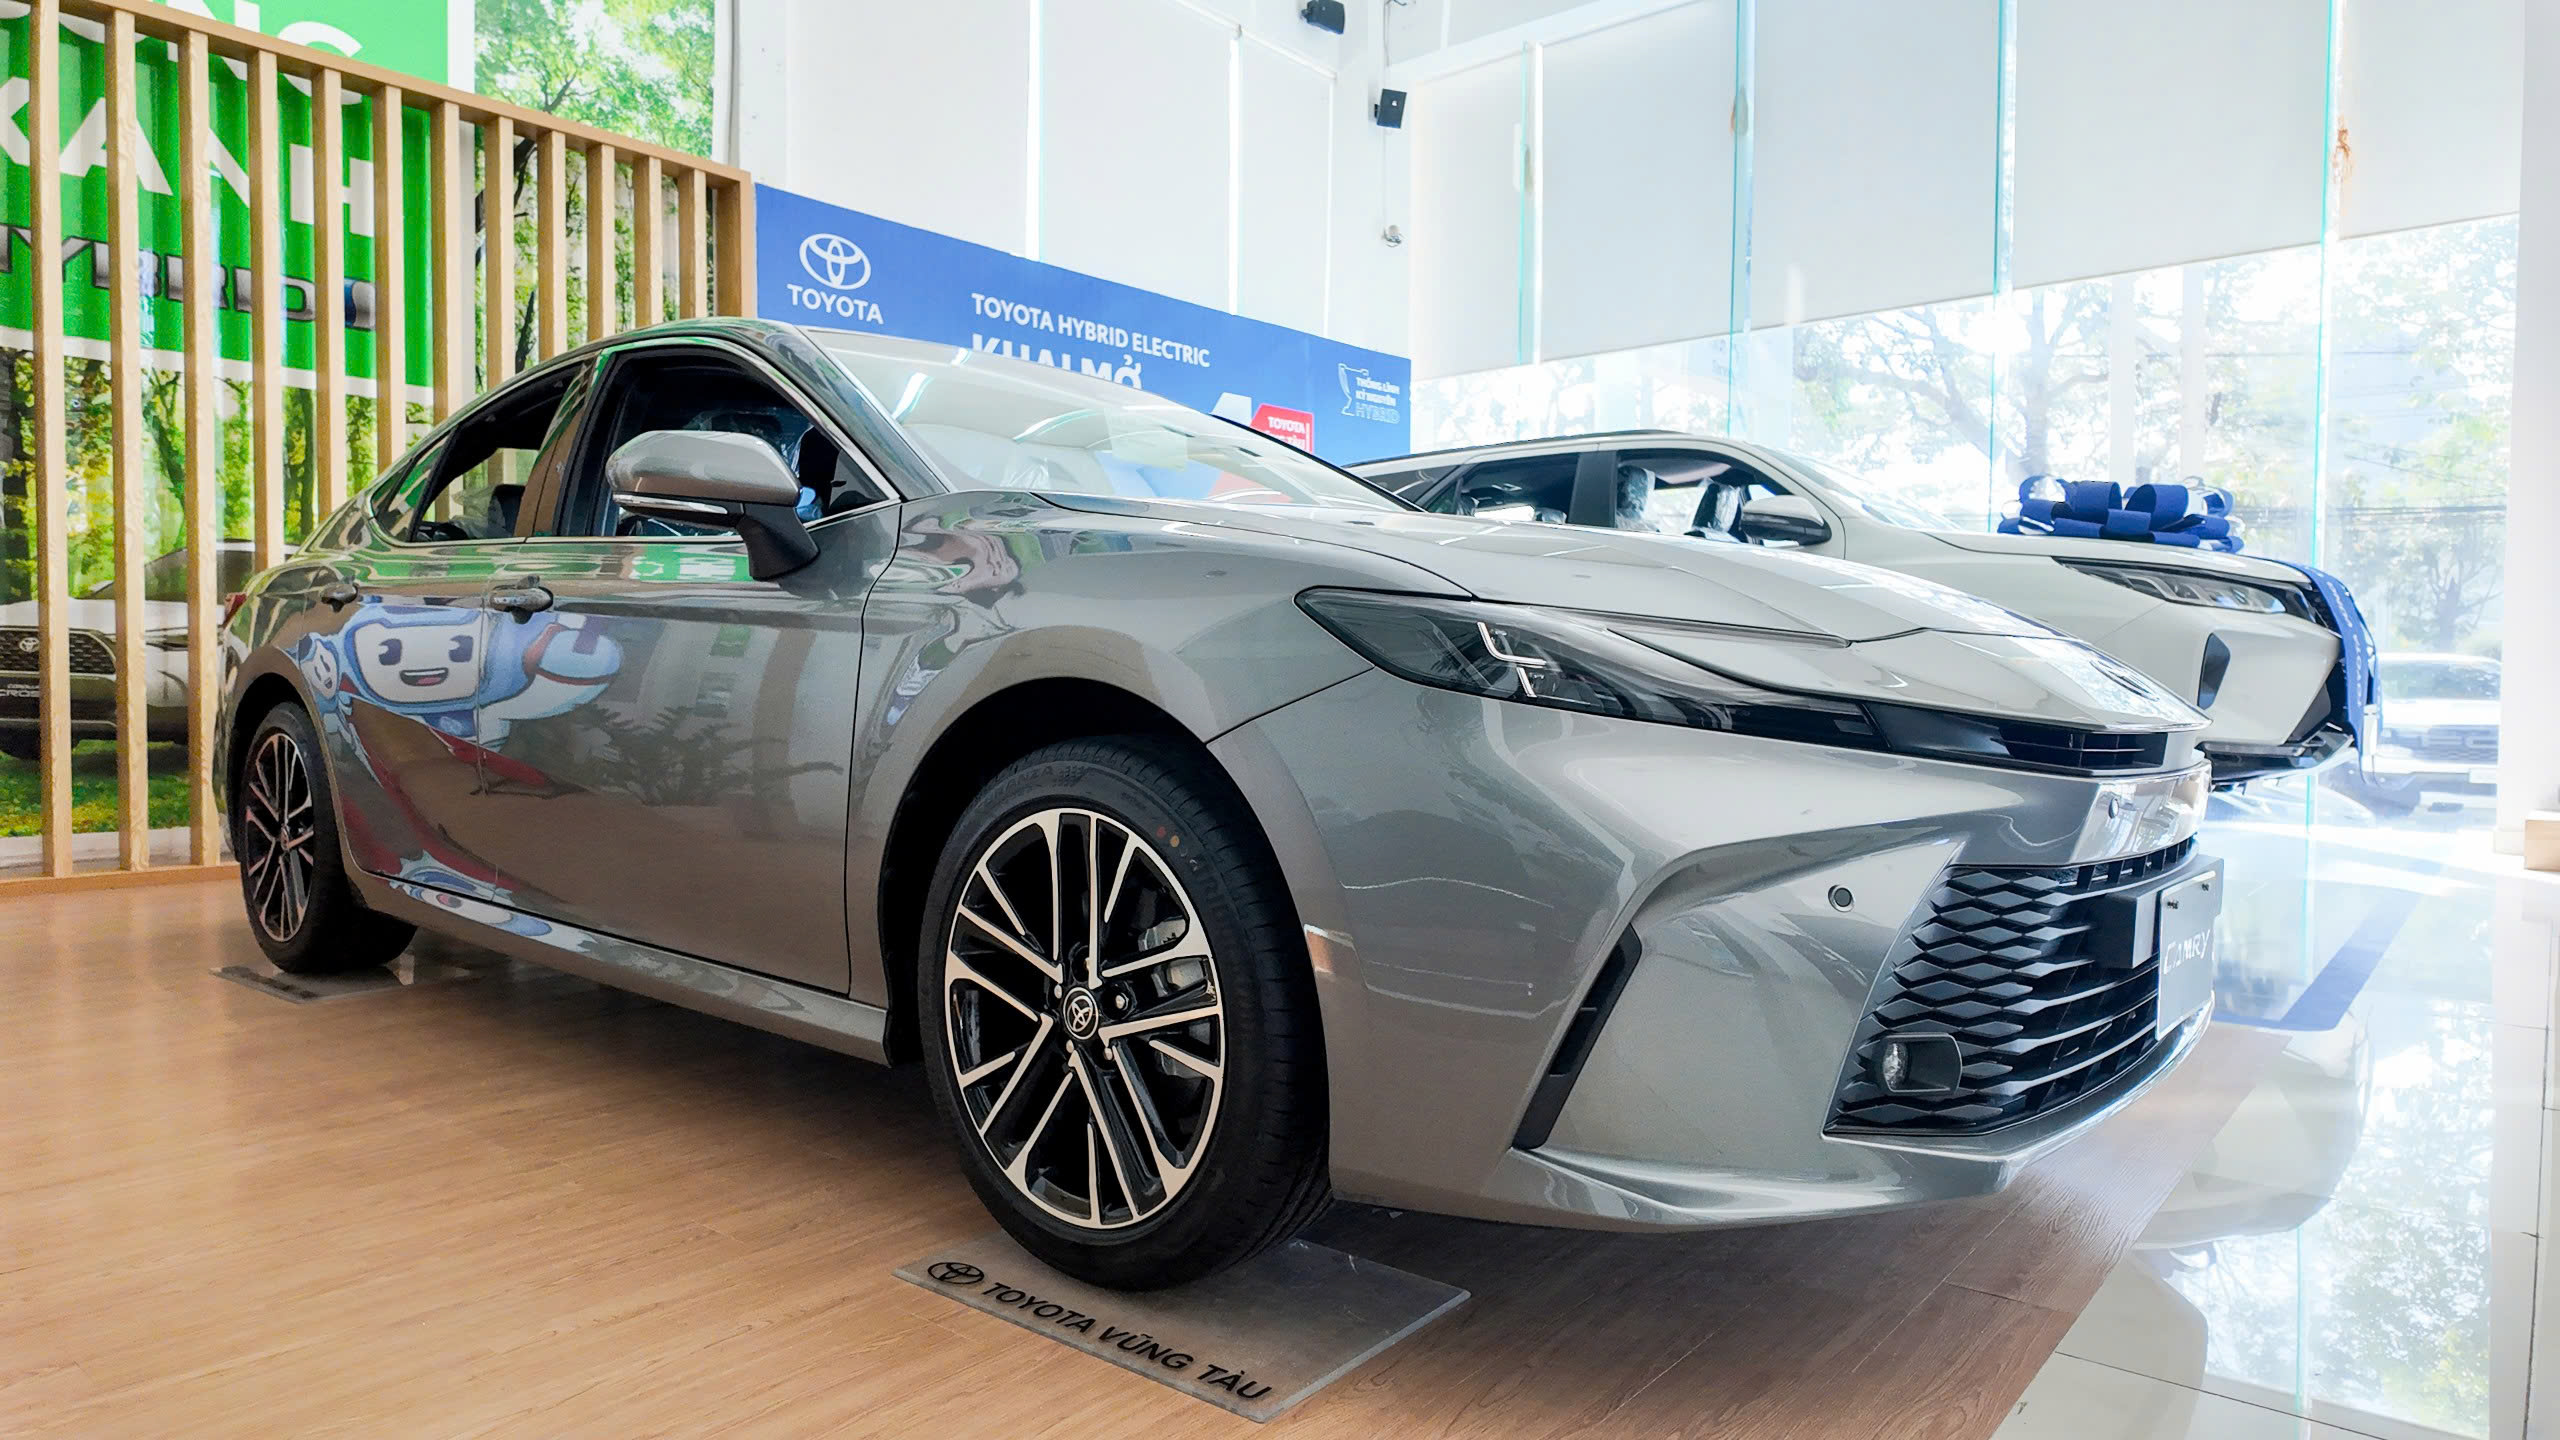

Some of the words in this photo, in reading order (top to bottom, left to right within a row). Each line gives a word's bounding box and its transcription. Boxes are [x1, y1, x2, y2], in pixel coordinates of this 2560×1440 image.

[786, 283, 884, 325] TOYOTA
[971, 293, 1055, 333] TOYOTA
[1058, 314, 1129, 348] HYBRID
[1132, 332, 1211, 368] ELECTRIC
[1267, 416, 1306, 434] TOYOTA
[0, 689, 40, 698] CROS
[2163, 929, 2211, 975] CAMRY
[982, 1282, 1096, 1333] TOYOTA
[1098, 1326, 1194, 1370] VŨNG
[1197, 1364, 1272, 1399] TÀU
